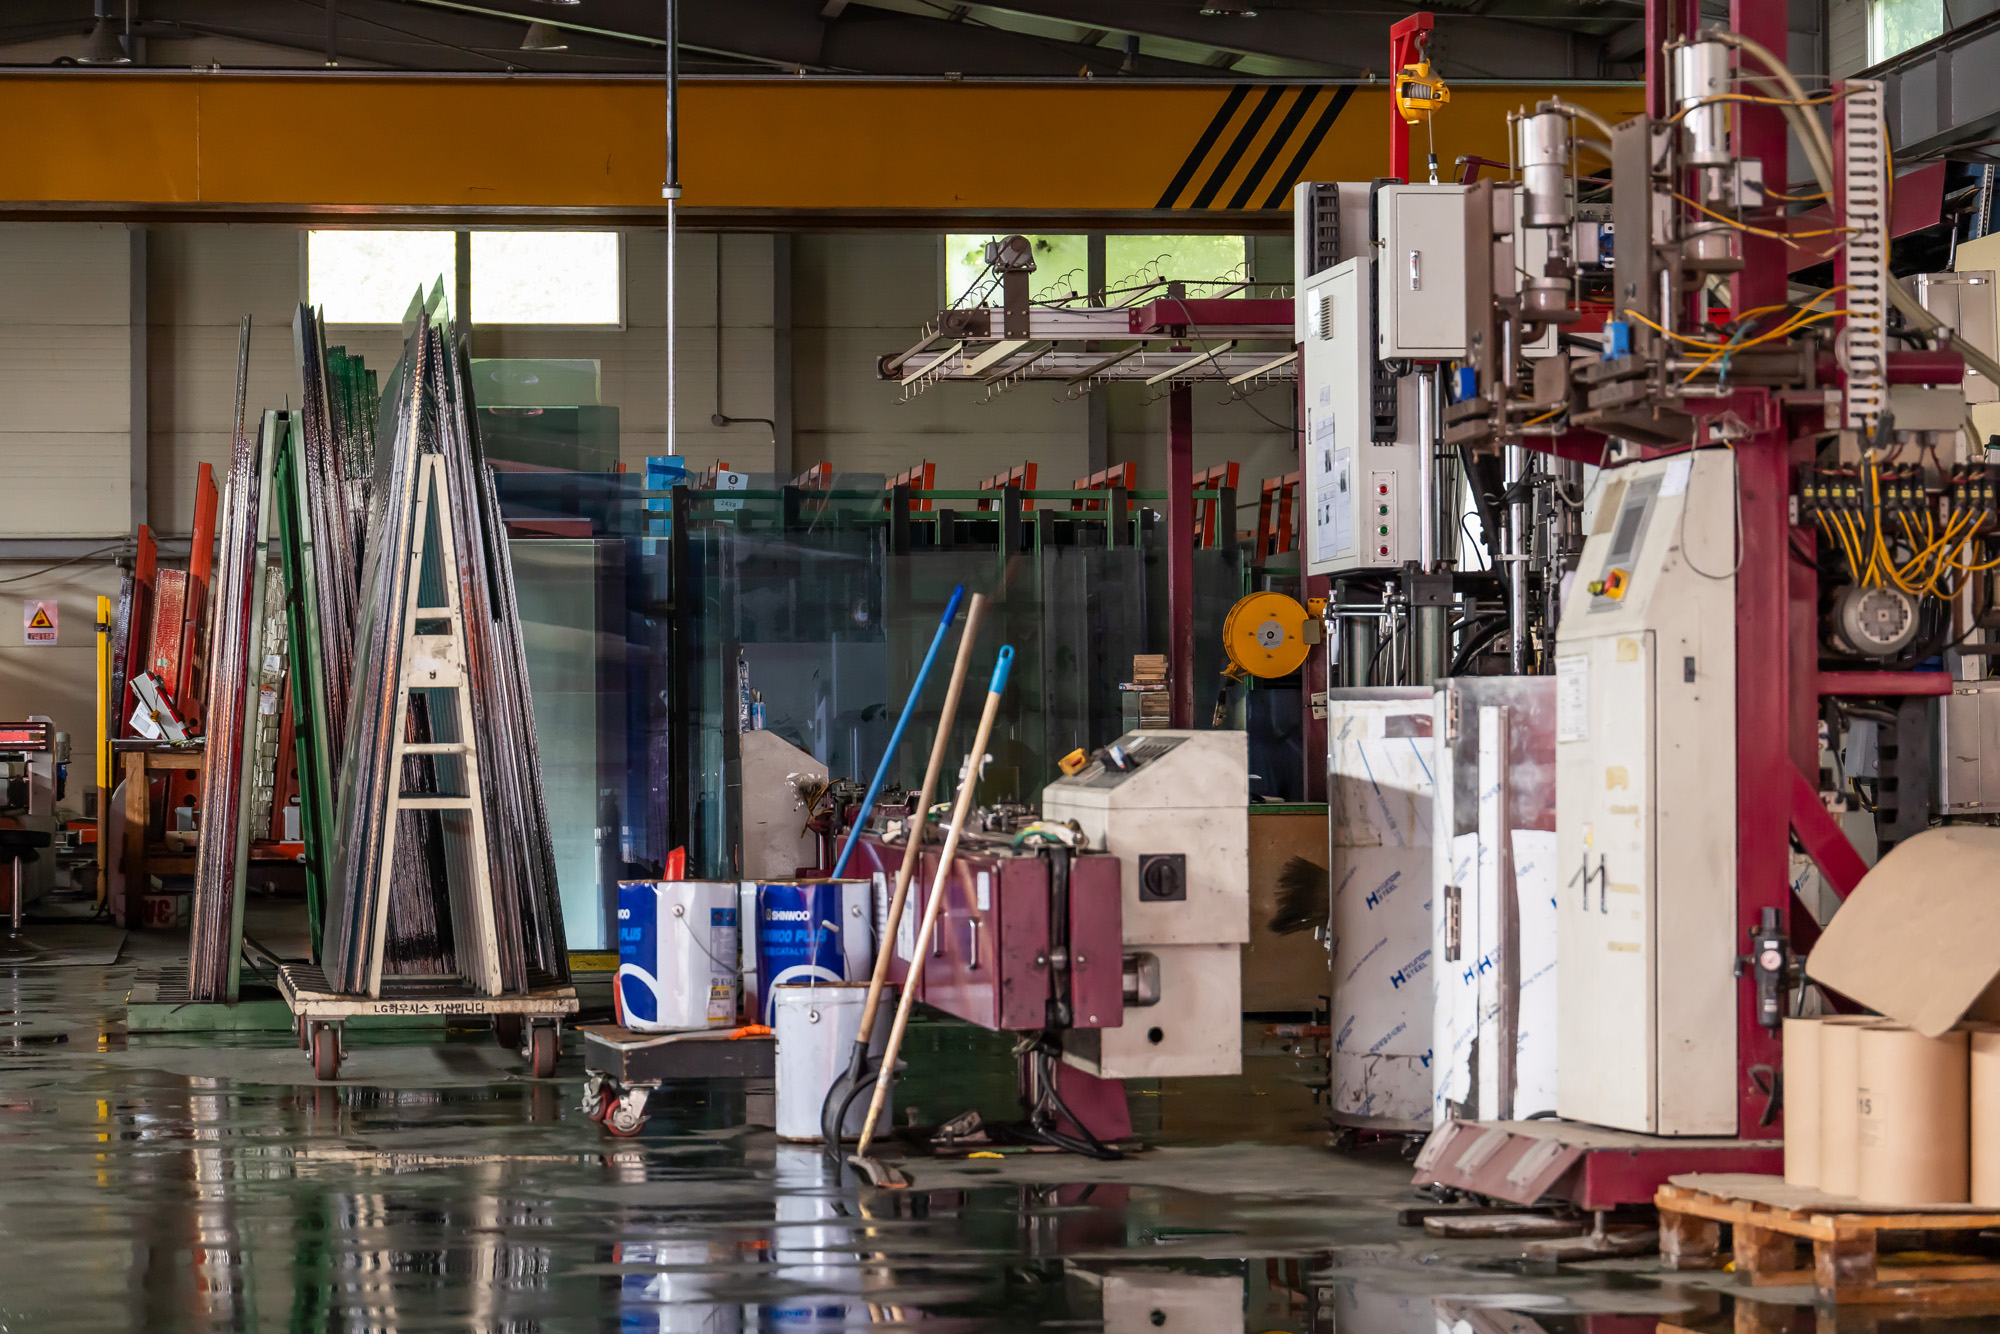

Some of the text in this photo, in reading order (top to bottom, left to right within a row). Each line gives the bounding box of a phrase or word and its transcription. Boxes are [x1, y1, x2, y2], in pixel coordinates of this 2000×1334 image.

[771, 910, 811, 922] SHINWOO
[795, 928, 828, 943] PLUS
[1405, 961, 1429, 980] STEEL
[374, 1003, 485, 1014] LG하우시스 자산입니다
